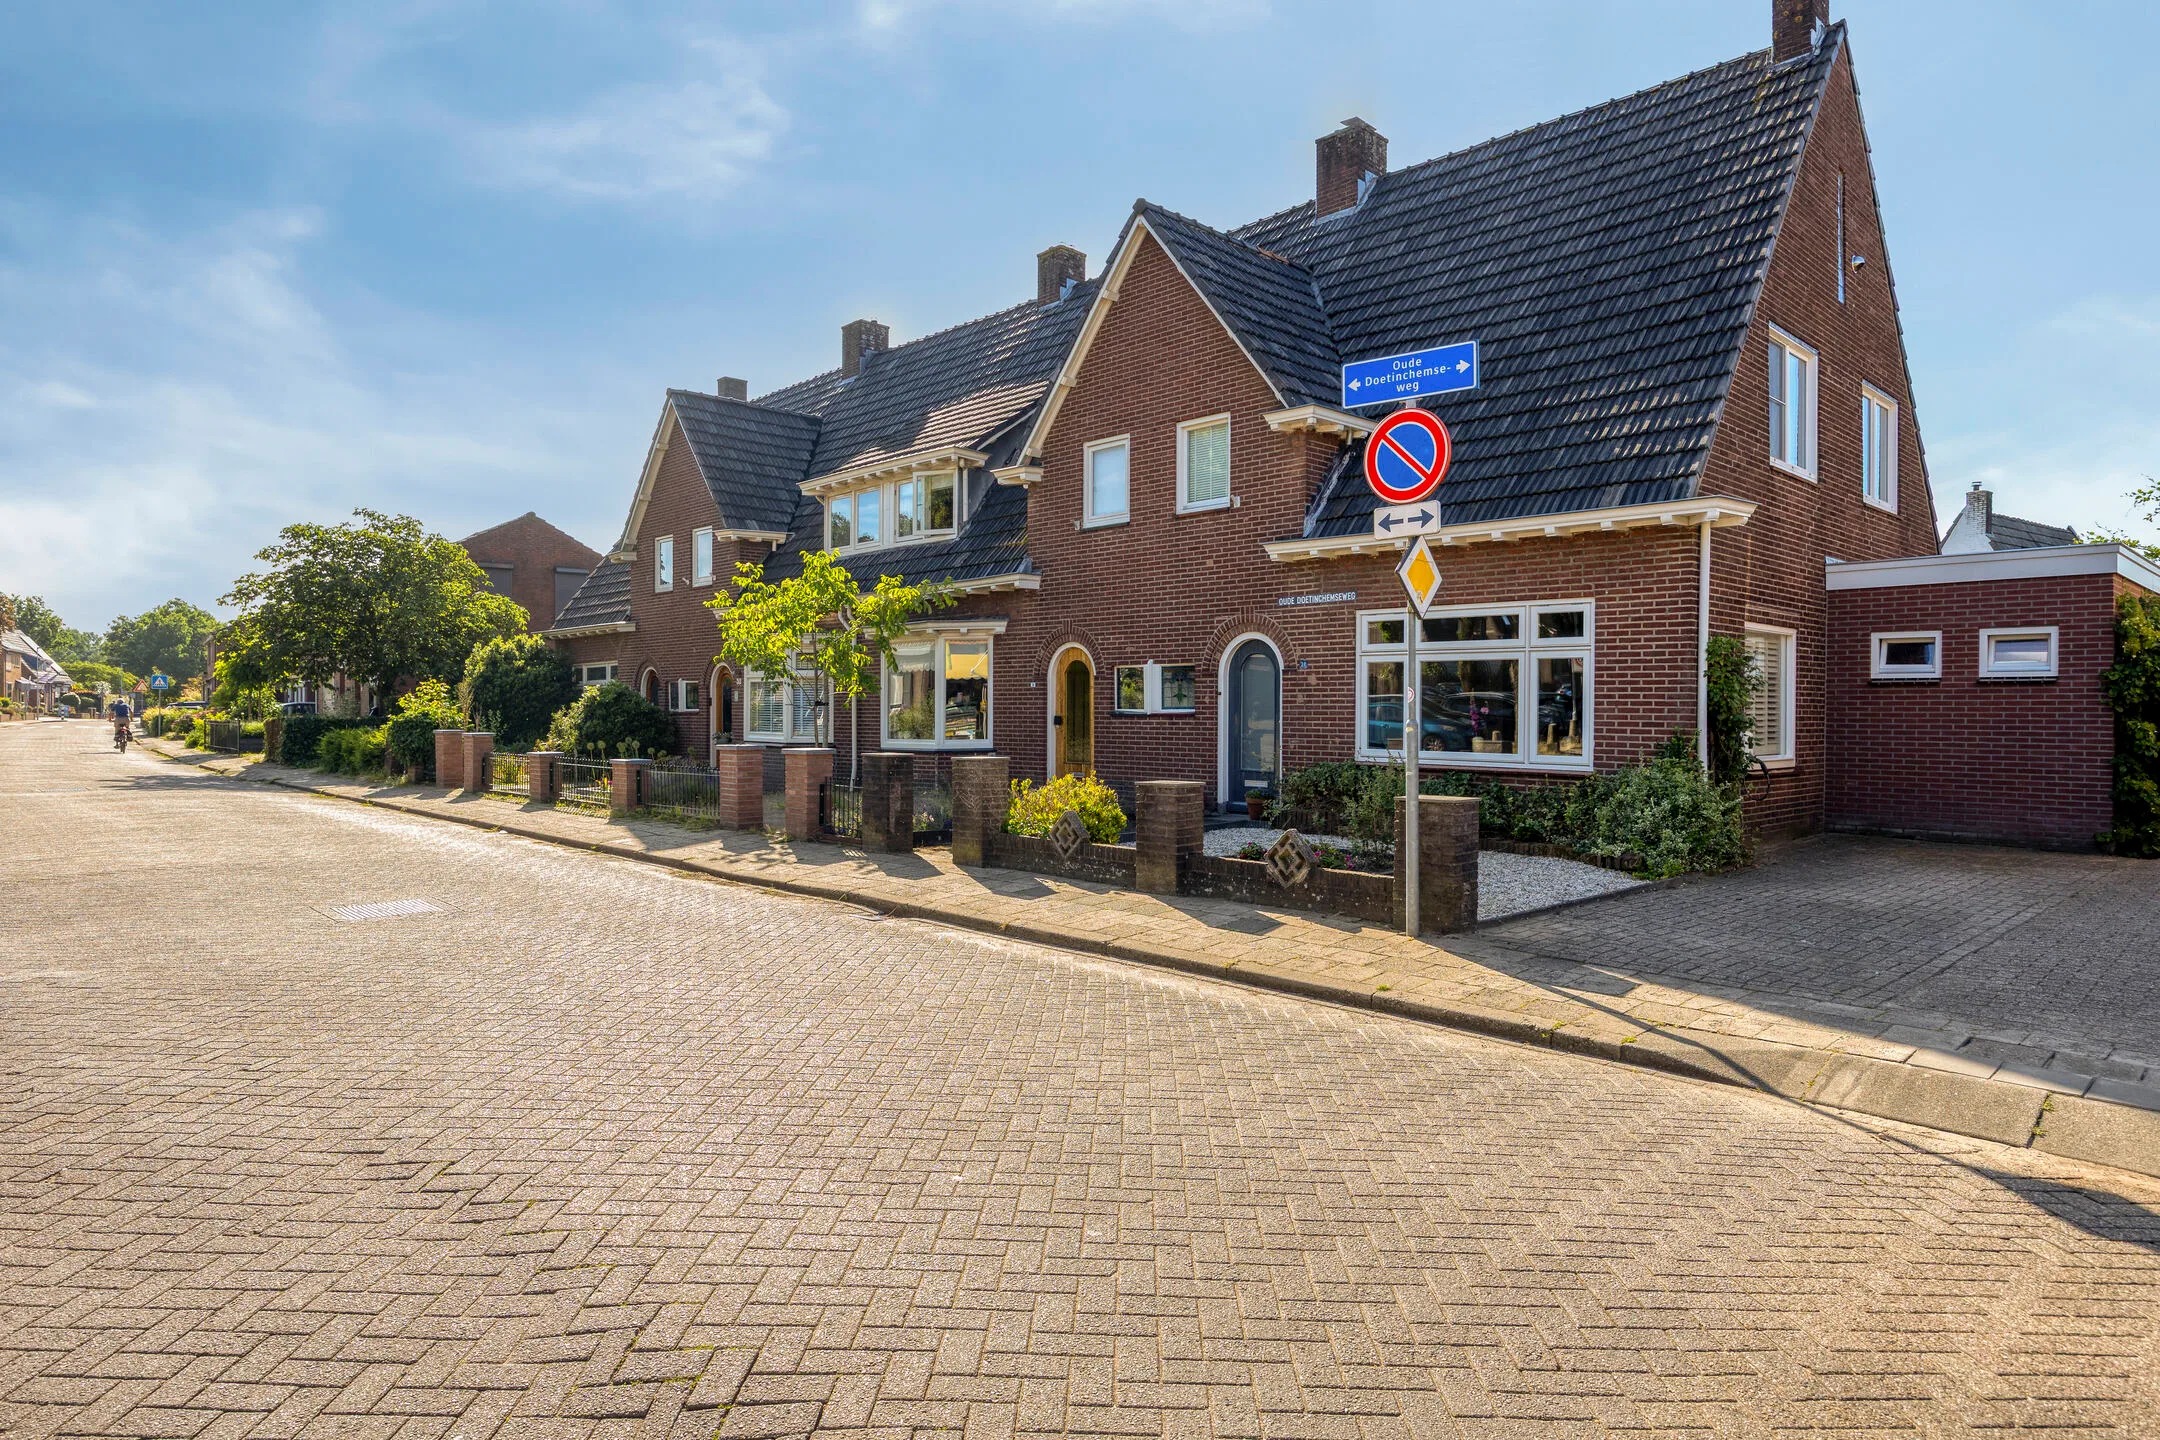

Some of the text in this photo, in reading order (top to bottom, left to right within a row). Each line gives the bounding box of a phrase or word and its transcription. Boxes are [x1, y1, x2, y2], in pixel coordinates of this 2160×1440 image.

[1393, 358, 1422, 370] Oude
[1365, 365, 1452, 387] Doetinchemse-
[1396, 381, 1419, 392] weg
[1278, 591, 1356, 606] OUDE DOETINCHEMSEWEG
